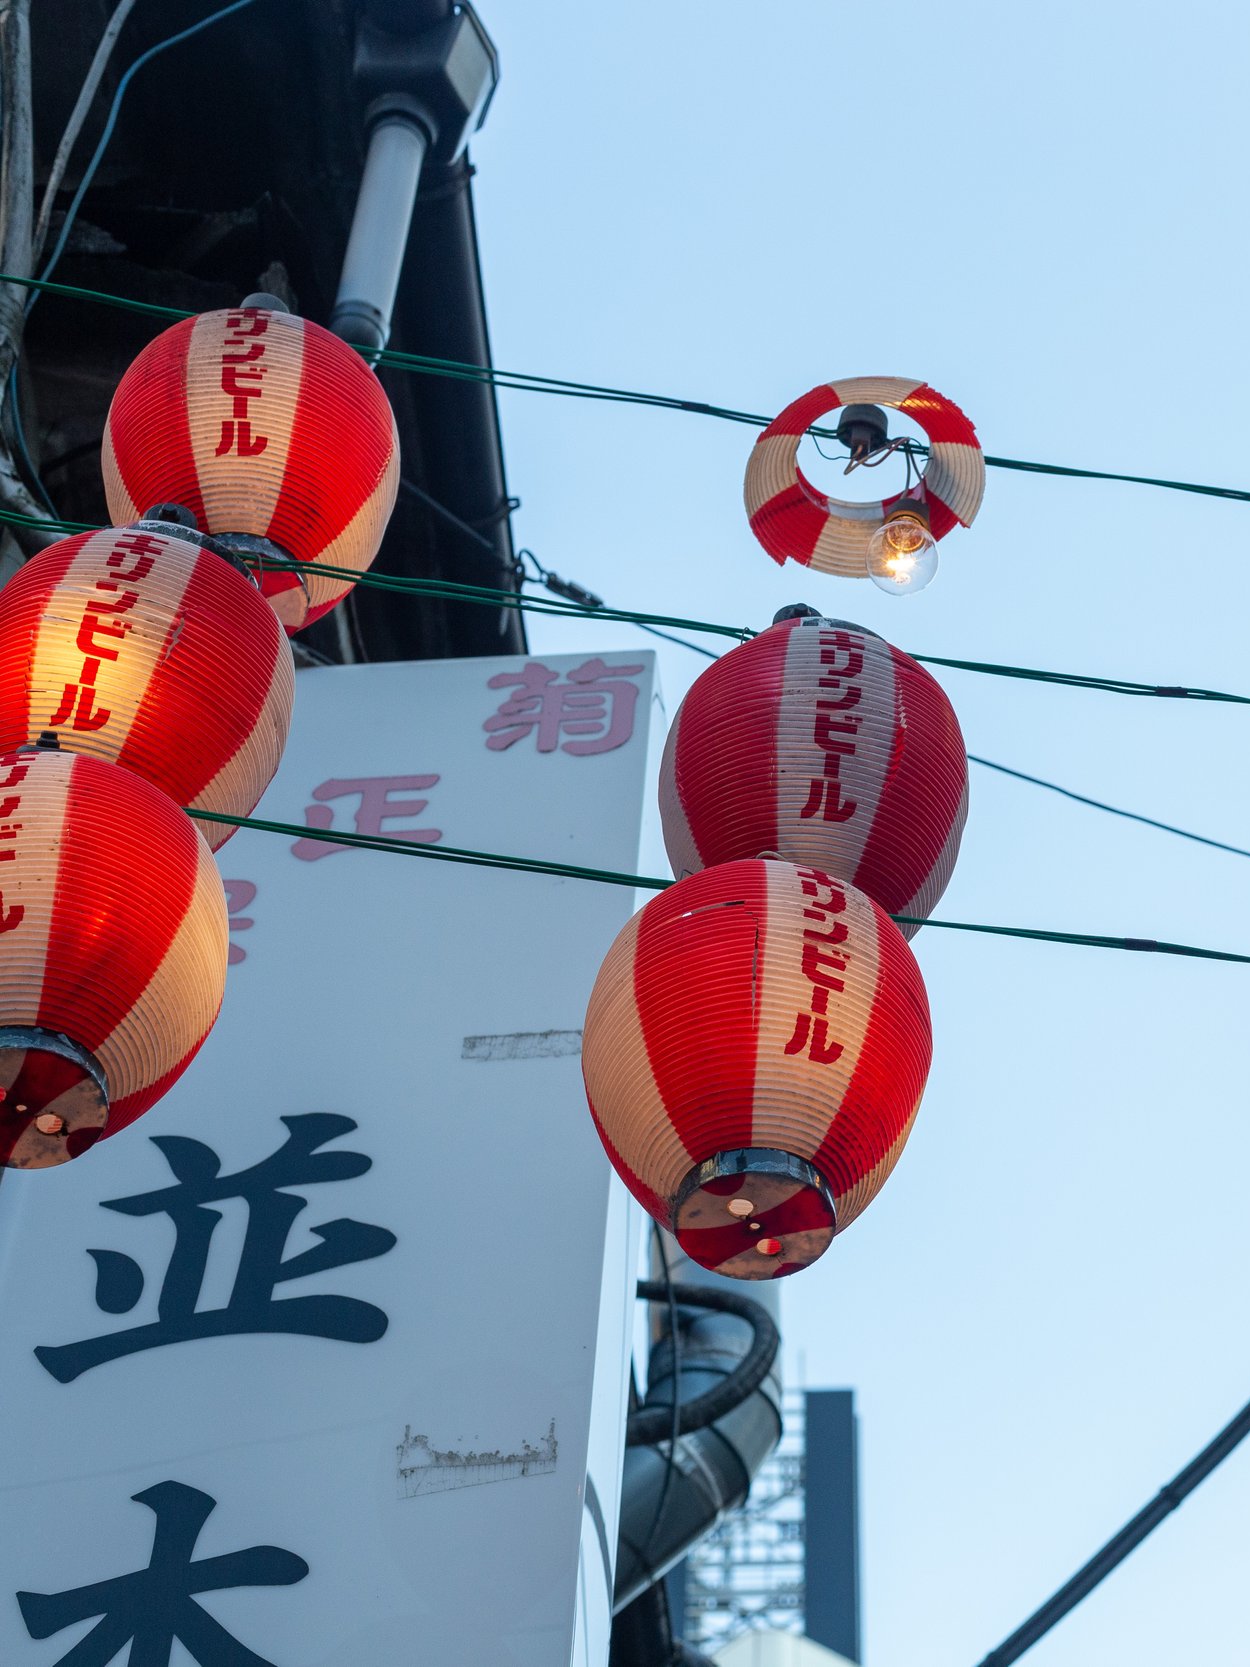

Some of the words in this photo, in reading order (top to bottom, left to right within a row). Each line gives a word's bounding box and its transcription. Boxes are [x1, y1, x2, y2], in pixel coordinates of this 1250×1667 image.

[48, 533, 170, 732] キリンビール
[800, 630, 866, 822] キリンビール
[784, 864, 851, 1065] キリンビール
